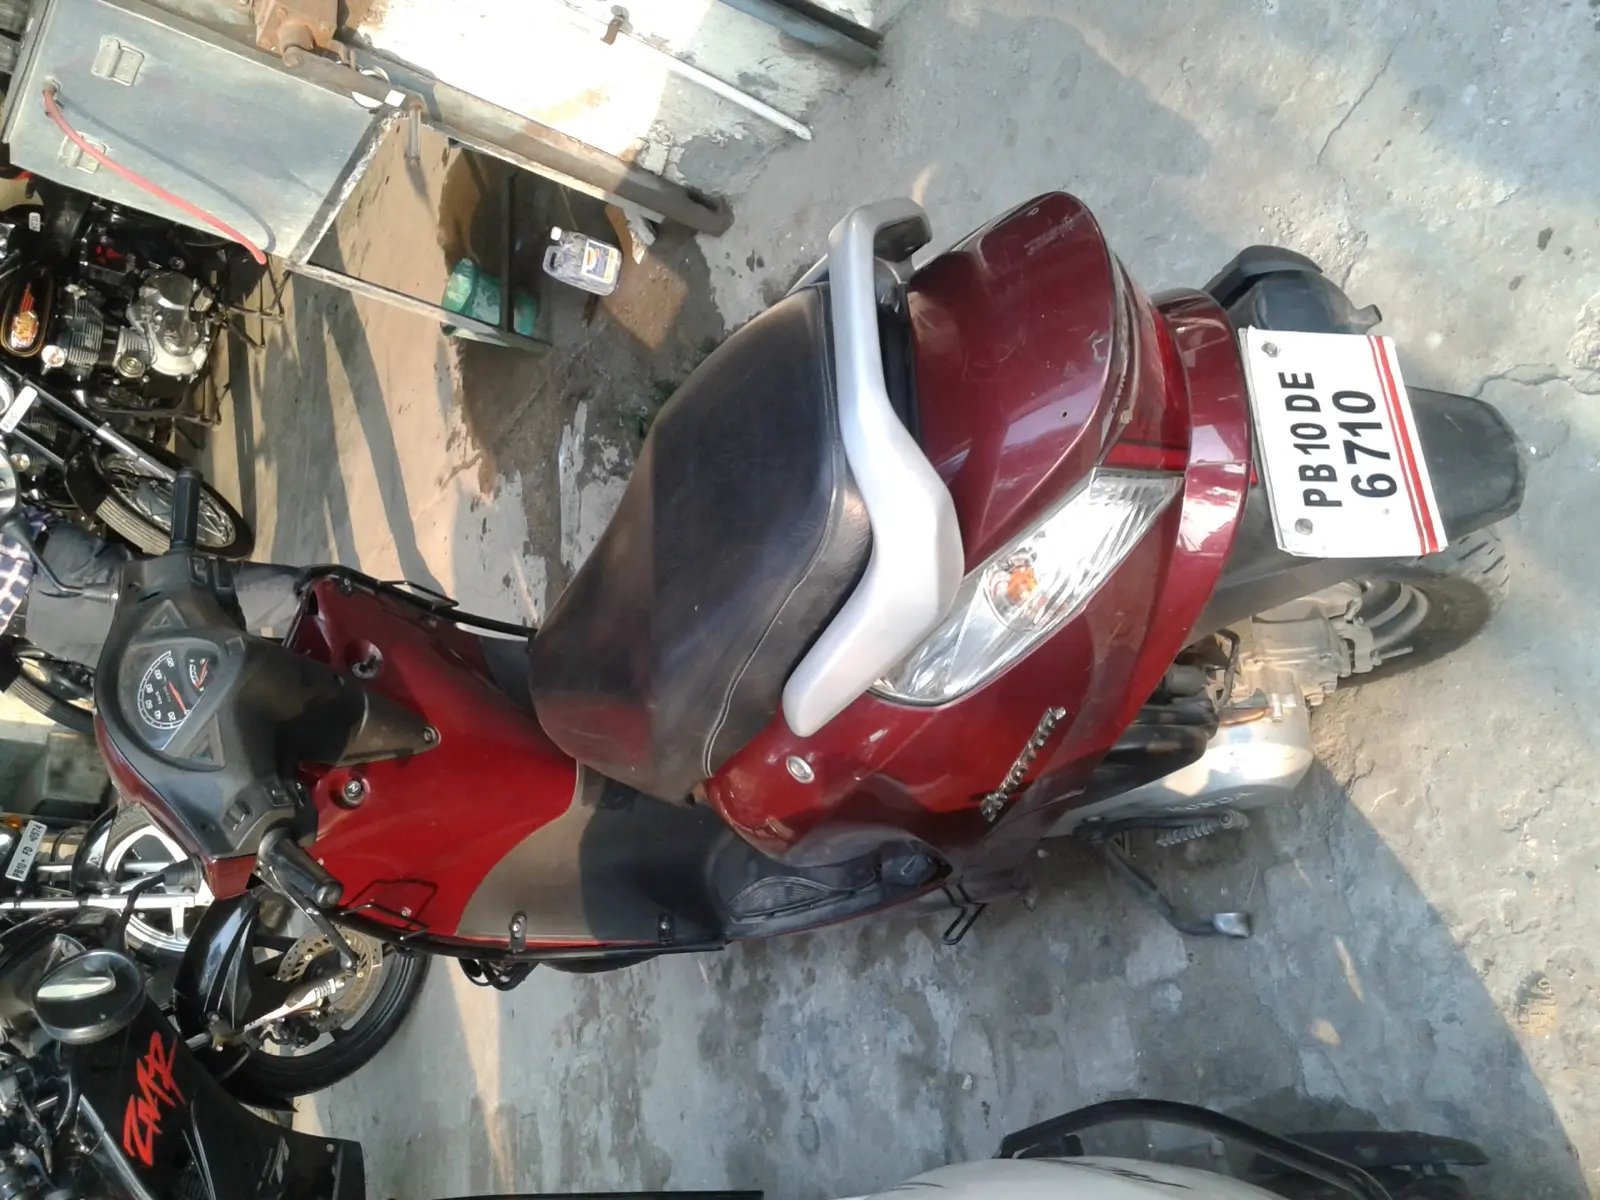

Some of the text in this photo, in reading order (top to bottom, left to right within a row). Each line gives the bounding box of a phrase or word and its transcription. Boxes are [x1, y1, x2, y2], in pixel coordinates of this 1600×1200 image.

[1278, 372, 1342, 507] PB 10 DE
[1332, 391, 1397, 498] 6710
[123, 1031, 186, 1166] ZMR
